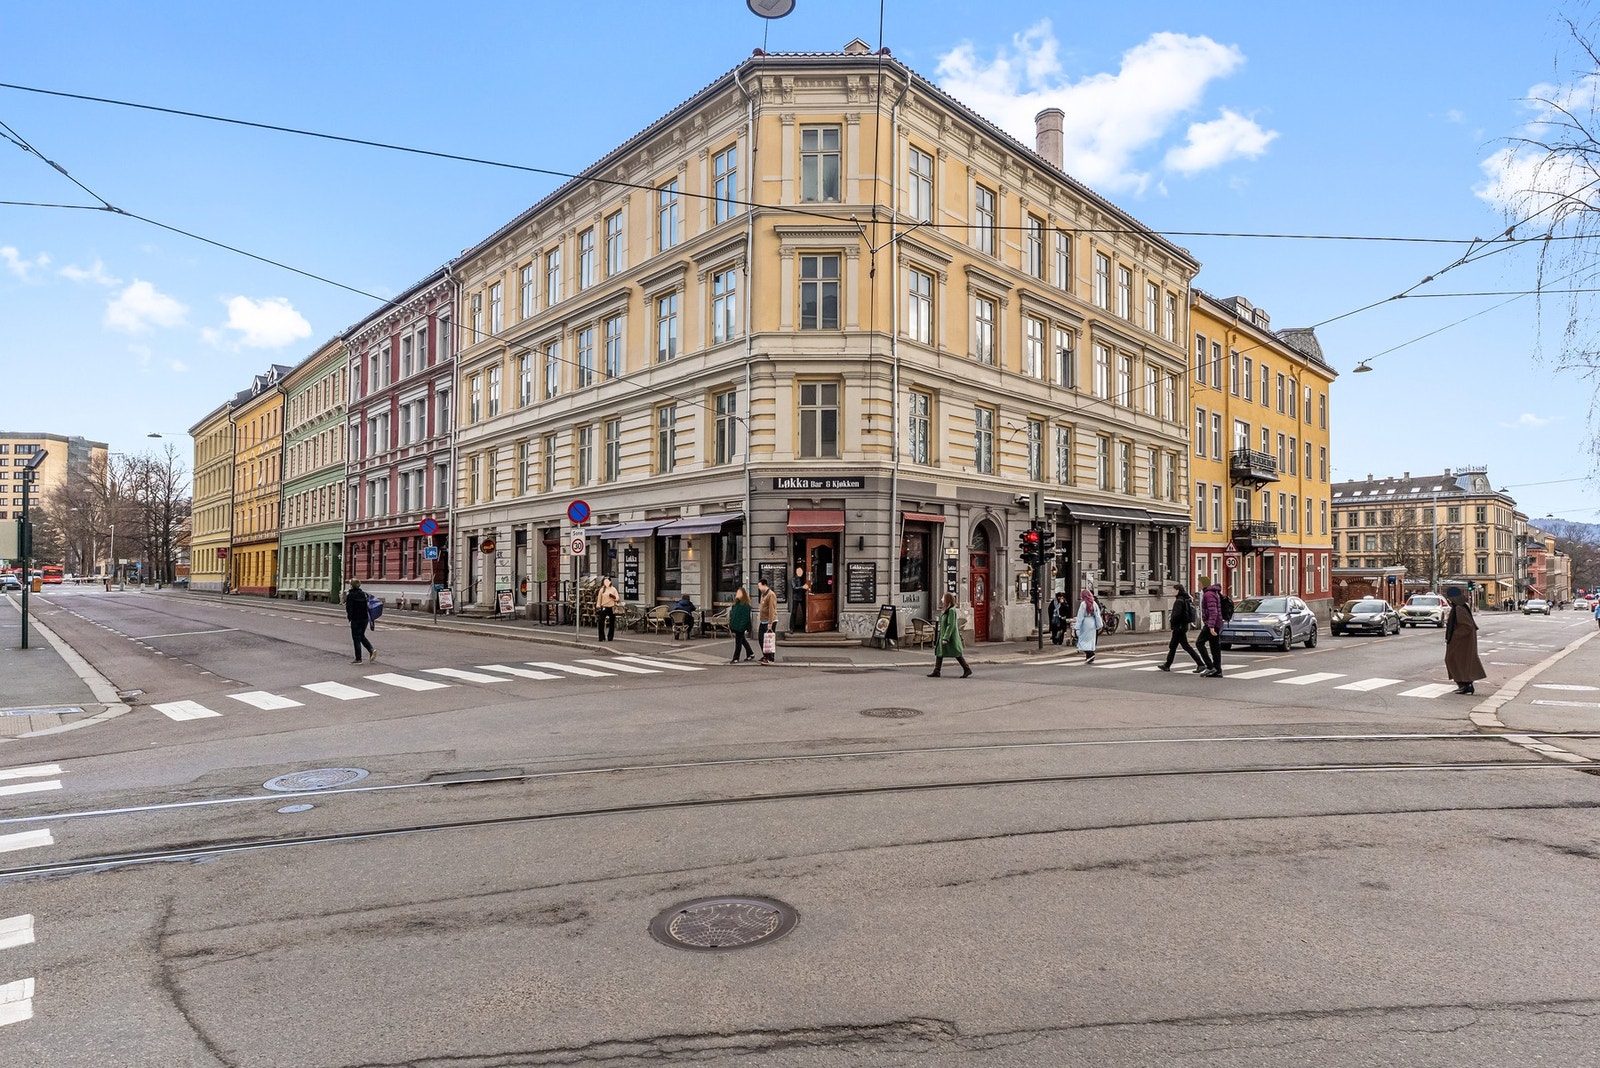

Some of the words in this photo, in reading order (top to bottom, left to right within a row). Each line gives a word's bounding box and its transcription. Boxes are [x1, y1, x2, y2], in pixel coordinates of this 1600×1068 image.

[778, 478, 808, 488] Løkka
[832, 480, 860, 488] Kjøkken
[574, 542, 582, 550] 30
[902, 594, 920, 603] Løkka
